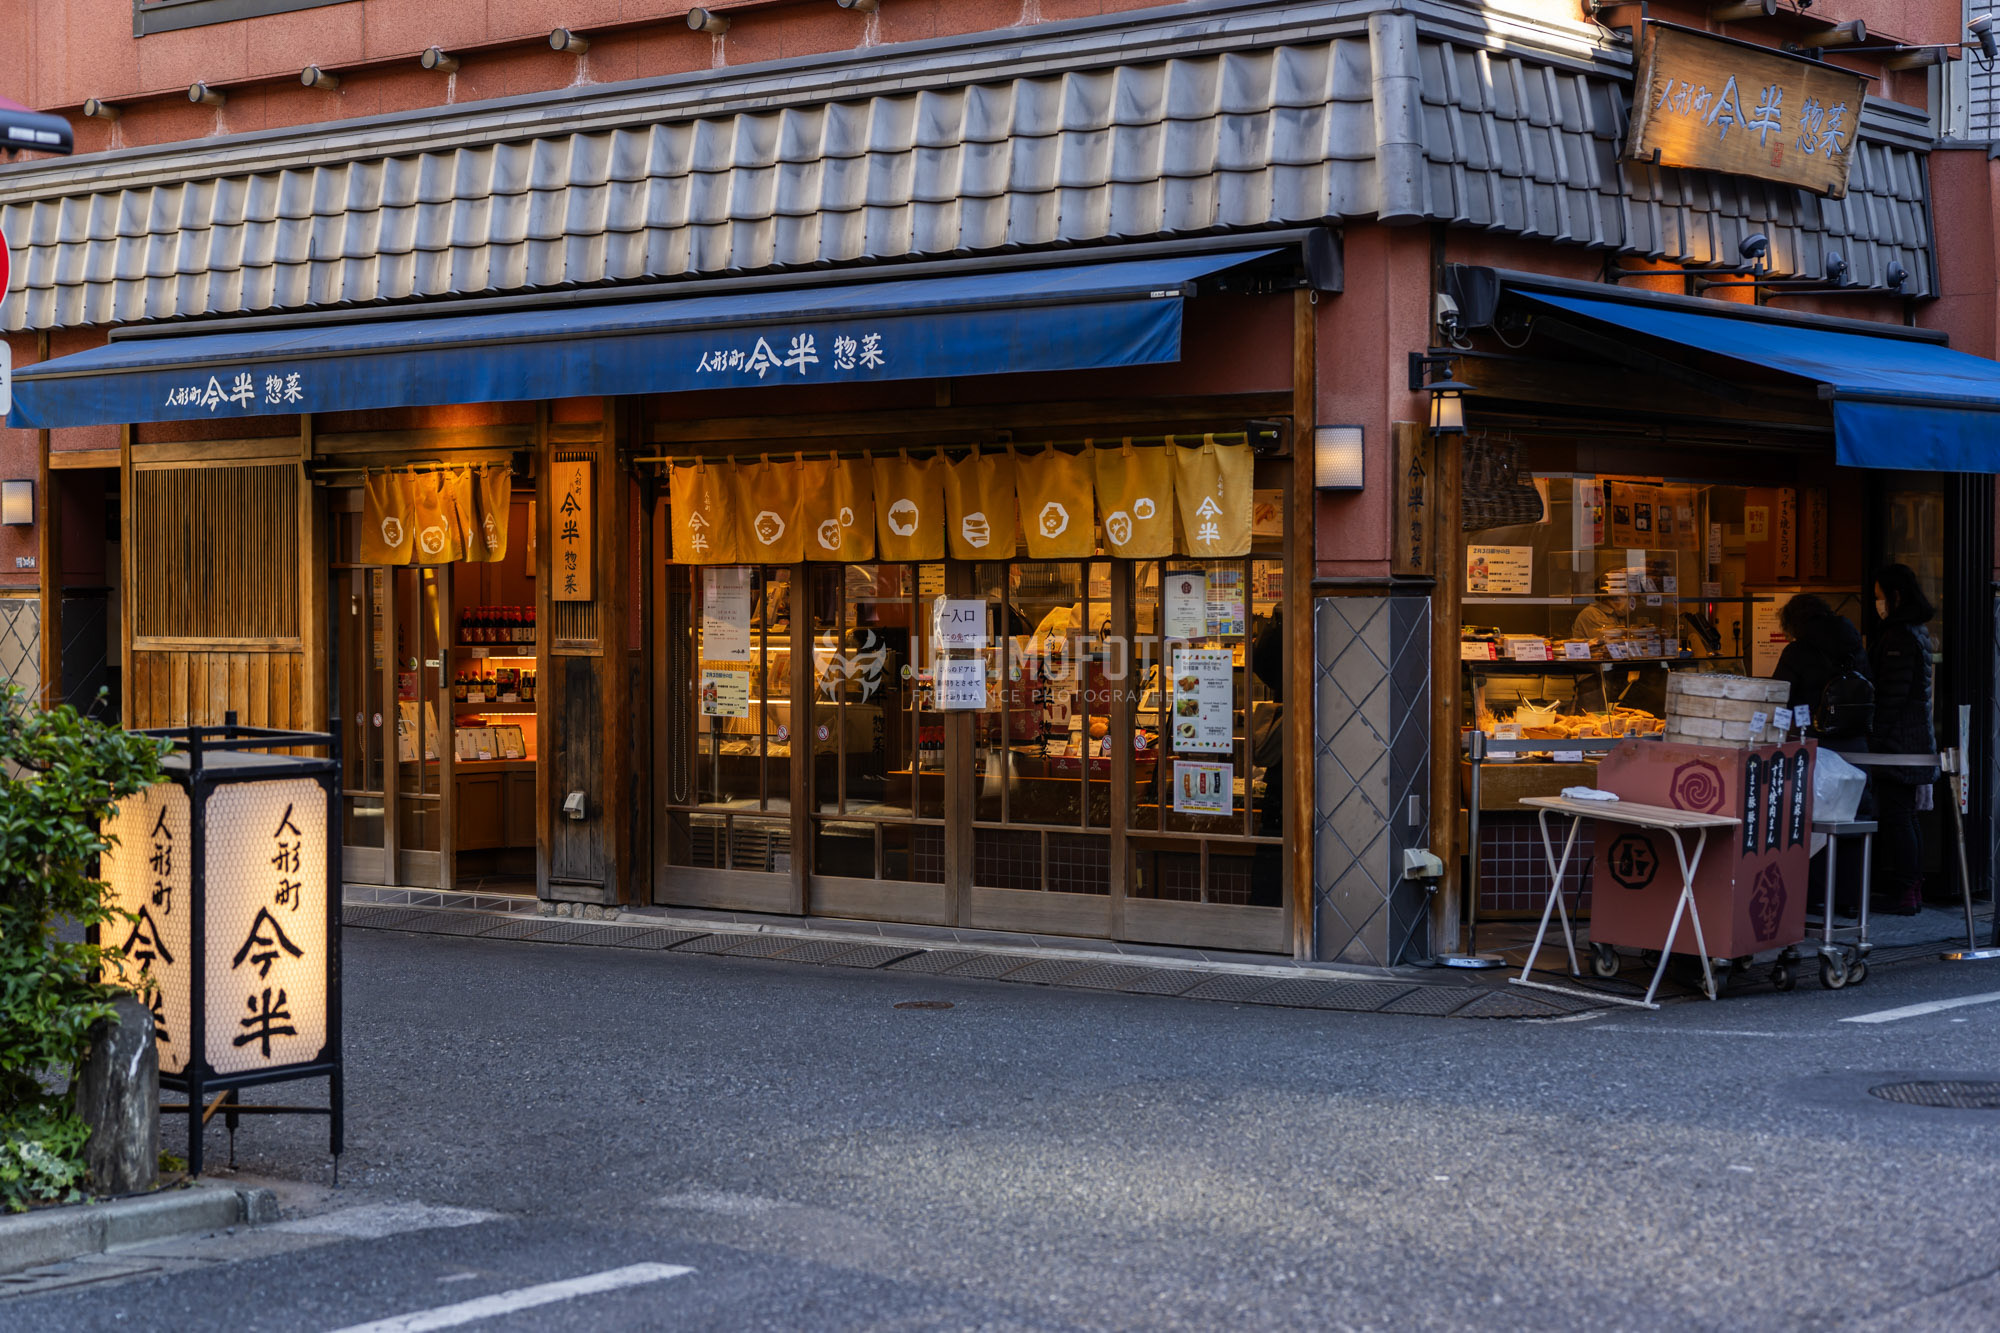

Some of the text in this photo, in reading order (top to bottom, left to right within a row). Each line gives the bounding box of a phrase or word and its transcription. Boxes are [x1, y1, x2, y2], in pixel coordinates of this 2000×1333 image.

[1656, 74, 1849, 160] 人形町今半 惣菜
[695, 332, 886, 379] 人形町今半 惣菜
[165, 371, 304, 413] 人形町今半 惣菜
[1407, 455, 1426, 513] 今半
[482, 512, 498, 551] 今半
[560, 492, 582, 595] 今半 惣菜
[688, 511, 710, 554] 今半
[1195, 495, 1224, 546] 今半
[951, 609, 975, 623] 入口
[150, 805, 173, 916] 人形町
[272, 802, 302, 912] 人形町
[232, 906, 304, 1059] 今半
